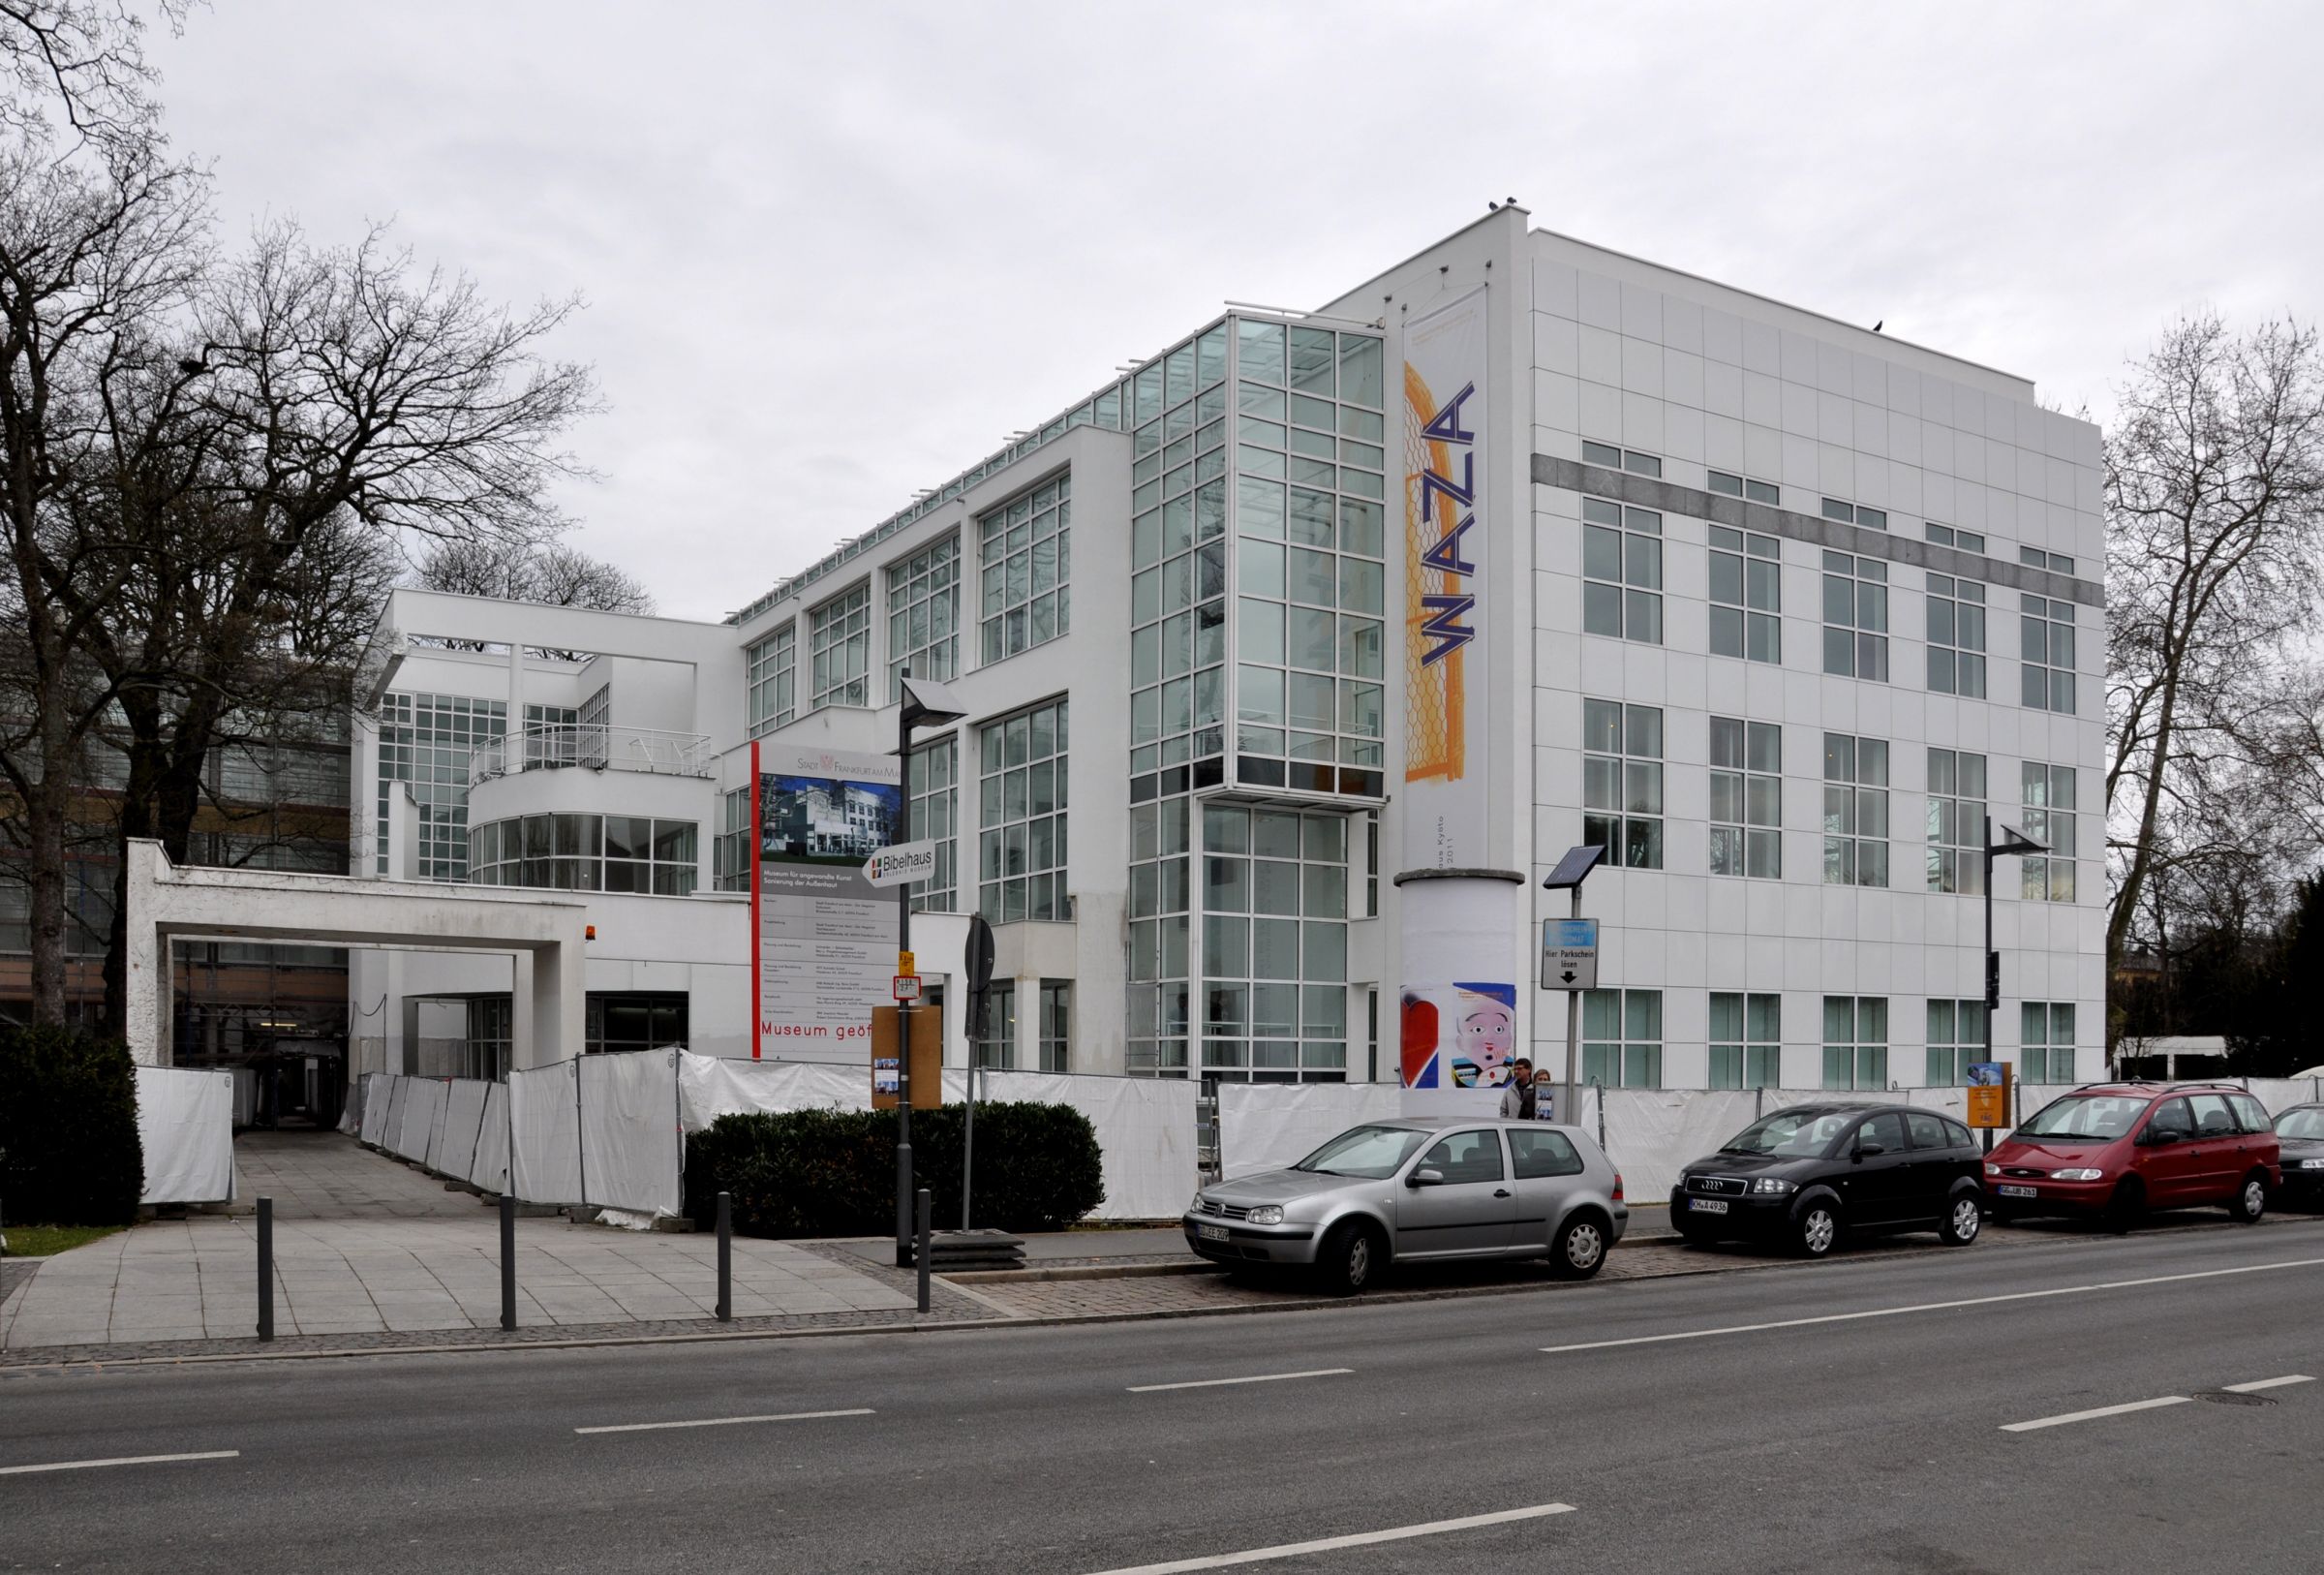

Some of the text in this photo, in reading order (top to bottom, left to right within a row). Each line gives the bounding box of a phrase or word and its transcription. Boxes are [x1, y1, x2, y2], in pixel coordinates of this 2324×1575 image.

[1421, 380, 1476, 668] WAZA
[883, 851, 932, 872] Bibelhaus
[799, 872, 835, 881] angewandte
[763, 877, 793, 887] Sanierung
[1545, 949, 1595, 958] Hier Parkschein
[761, 1020, 872, 1040] Museum geöf
[1709, 1202, 1727, 1211] 4936
